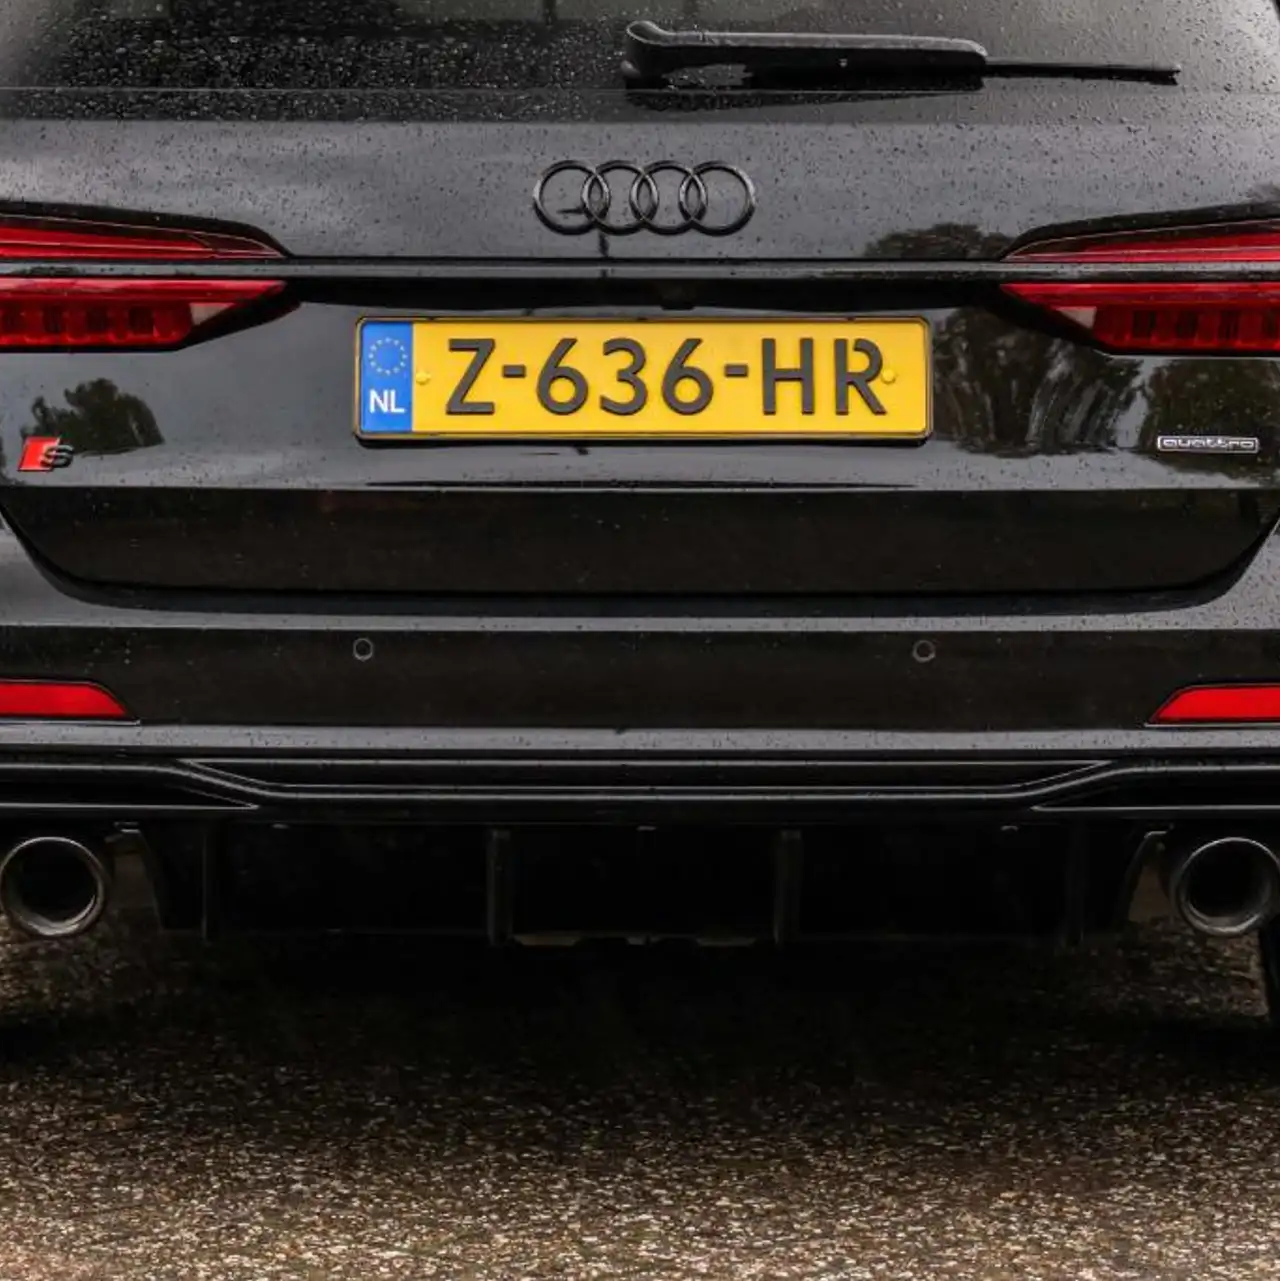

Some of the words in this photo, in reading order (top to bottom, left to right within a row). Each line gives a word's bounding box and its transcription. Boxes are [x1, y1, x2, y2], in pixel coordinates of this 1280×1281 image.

[445, 337, 888, 417] Z-636-HR
[368, 387, 406, 415] NL
[1162, 437, 1256, 450] quattro
